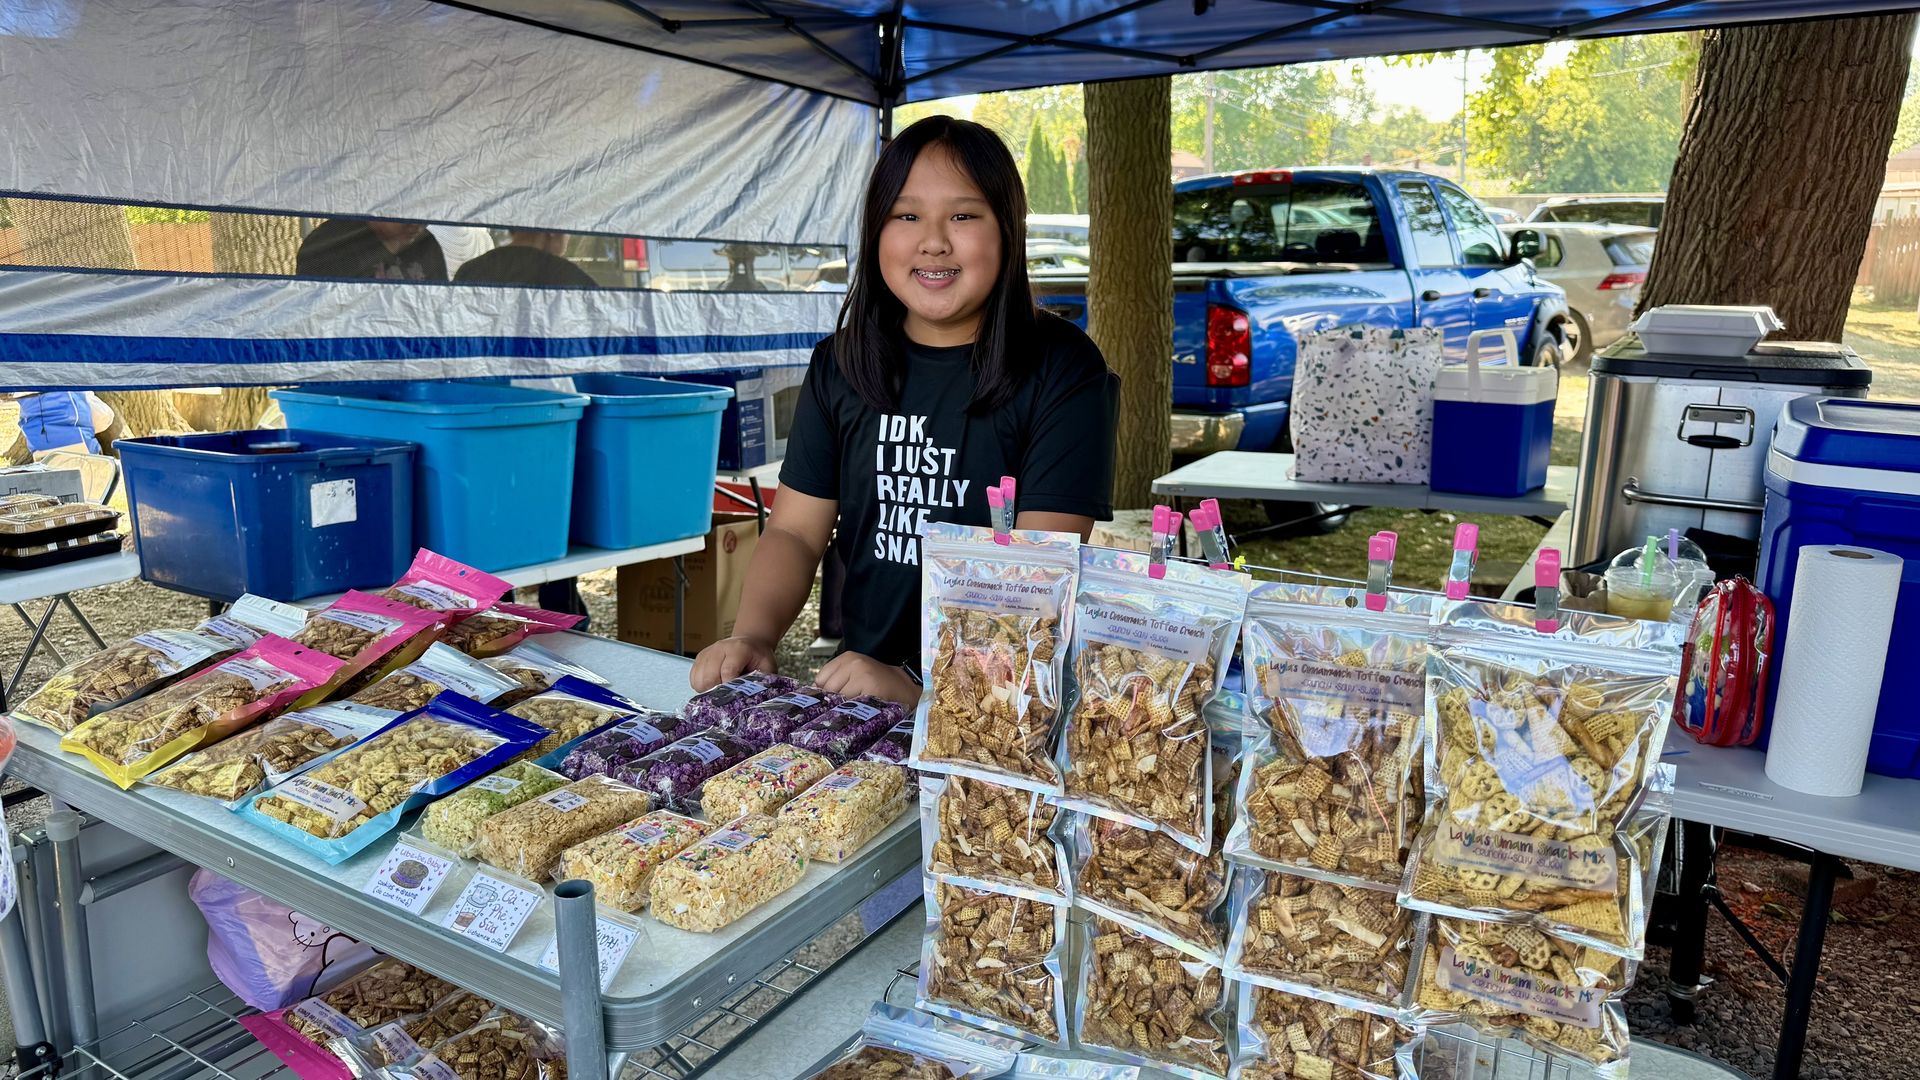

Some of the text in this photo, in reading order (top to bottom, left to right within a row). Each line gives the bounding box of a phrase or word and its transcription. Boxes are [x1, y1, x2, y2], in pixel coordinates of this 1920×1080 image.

[878, 414, 934, 447] IDK,
[876, 444, 956, 476] I JUST
[876, 475, 970, 507] REALLY
[878, 503, 931, 536] LIKE
[874, 532, 918, 566] SNA
[1355, 670, 1390, 684] Toffee
[1494, 835, 1534, 854] Umami
[1538, 841, 1579, 860] Snack
[1535, 979, 1575, 1000] Snack
